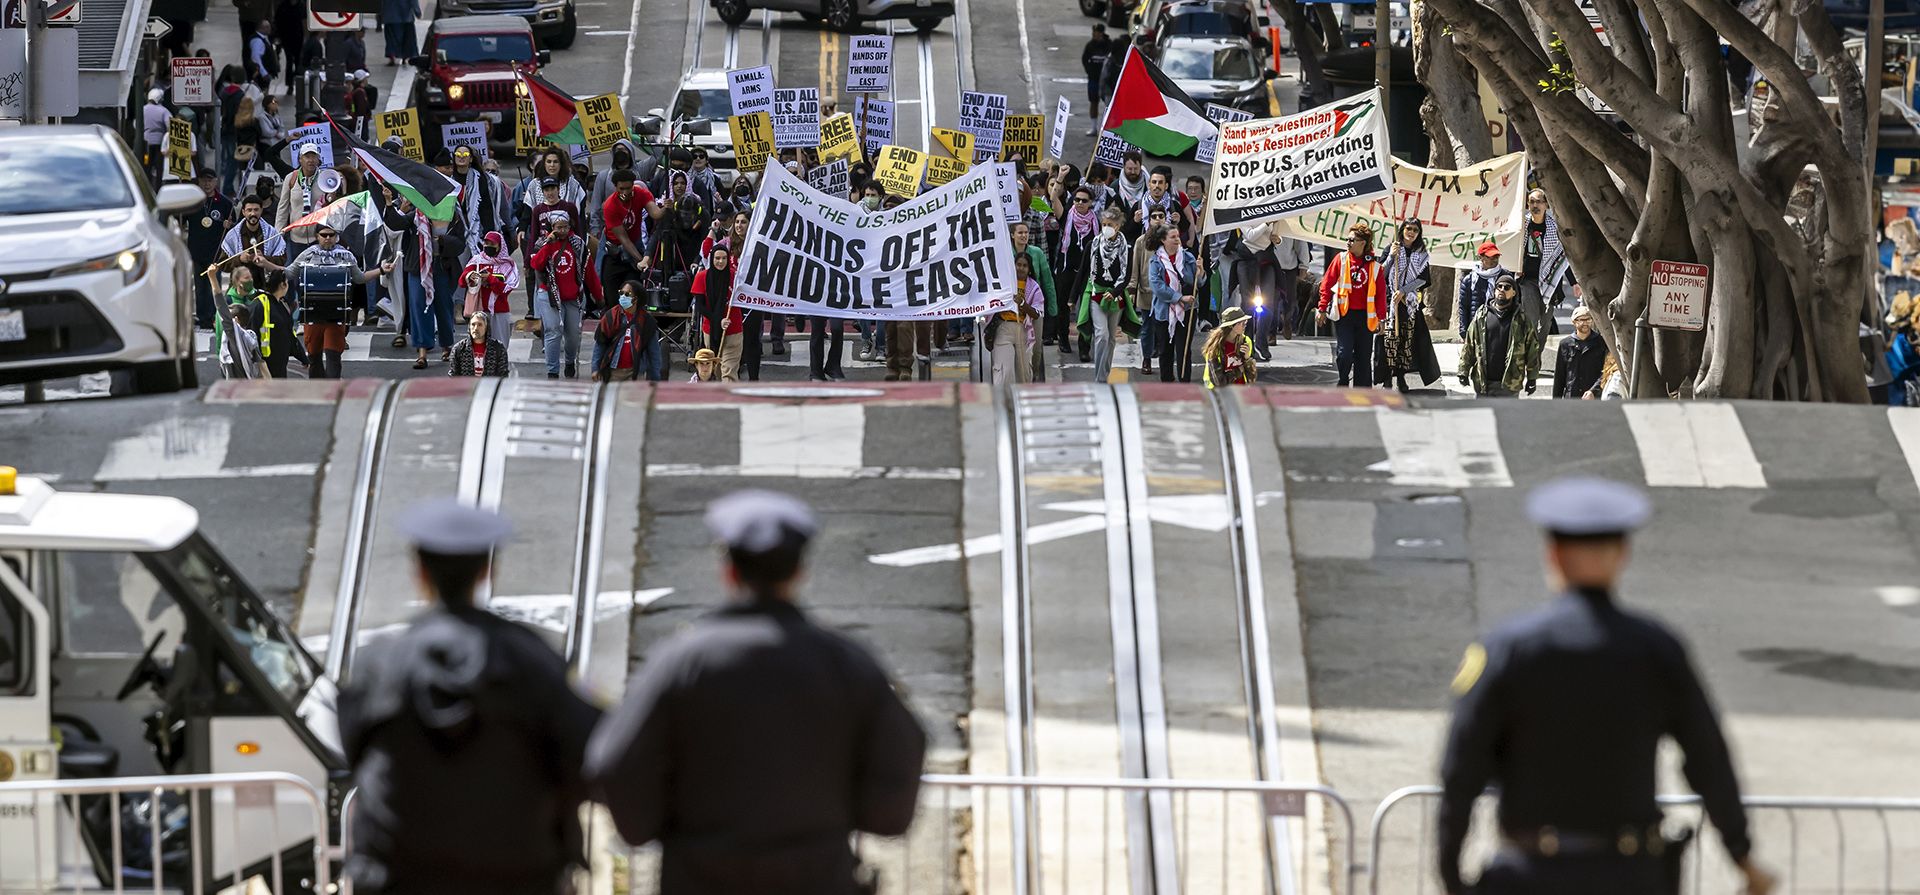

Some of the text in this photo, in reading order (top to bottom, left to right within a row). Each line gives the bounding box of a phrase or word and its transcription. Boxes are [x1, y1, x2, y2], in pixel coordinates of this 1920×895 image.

[1368, 18, 1404, 27] Ser
[857, 40, 885, 48] KAMALA:
[852, 52, 888, 60] HANDS OFF
[174, 66, 210, 76] NO STOPPING
[850, 65, 888, 74] THE MIDDLE
[735, 71, 765, 84] KAMALA:
[860, 77, 876, 86] EAST
[742, 84, 761, 95] ARMS
[774, 89, 818, 102] END ALL
[583, 97, 611, 115] END
[738, 97, 770, 109] EMBARGO
[861, 102, 886, 113] KMALA:
[963, 93, 1005, 109] END ALL
[774, 102, 818, 115] U.S. AID
[962, 105, 1004, 121] U.S. AID
[1209, 106, 1229, 120] END
[383, 111, 409, 129] END
[594, 113, 610, 124] ALL
[738, 114, 760, 130] END
[775, 115, 818, 125] TO ISRAEL
[877, 117, 888, 126] OFF
[960, 117, 1002, 130] TO ISRAEL
[1027, 117, 1042, 128] US-
[170, 120, 189, 140] FREE
[391, 128, 406, 137] ALL
[450, 126, 478, 135] KAMALA:
[589, 122, 621, 136] U.S. AID
[820, 116, 851, 140] REE
[1224, 126, 1246, 139] Stand
[448, 137, 482, 146] HANDS OFF
[588, 138, 599, 147] TO
[743, 129, 763, 143] ALL
[819, 132, 854, 152] PALESTINE
[1222, 125, 1331, 156] People's Resistance!
[739, 142, 770, 155] U.S. AID
[738, 156, 748, 166] TO
[889, 147, 918, 164] END
[1220, 133, 1374, 179] STOP U.S. Funding
[810, 161, 847, 181] END ALL
[892, 162, 908, 172] ALL
[934, 158, 966, 172] U.S. AID
[881, 170, 914, 183] U.S. AID
[929, 168, 939, 177] TO
[1216, 185, 1230, 201] of
[1235, 178, 1286, 199] Israeli
[1291, 152, 1378, 190] Apartheid
[830, 173, 847, 186] AID
[885, 180, 916, 192] ISRAEL!
[818, 204, 849, 225] THE
[856, 194, 947, 228] U.S.-ISRAELI
[955, 176, 986, 203] WAR!
[1240, 187, 1358, 219] ANSWERCoalition.org
[758, 197, 996, 273] HANDS OFF THE
[744, 241, 1001, 309] MIDDLE EAST!
[1661, 263, 1700, 274] TOW-AWAY
[1653, 272, 1704, 289] NO STOPPING
[1665, 292, 1690, 302] ANY
[1663, 303, 1690, 315] TIME
